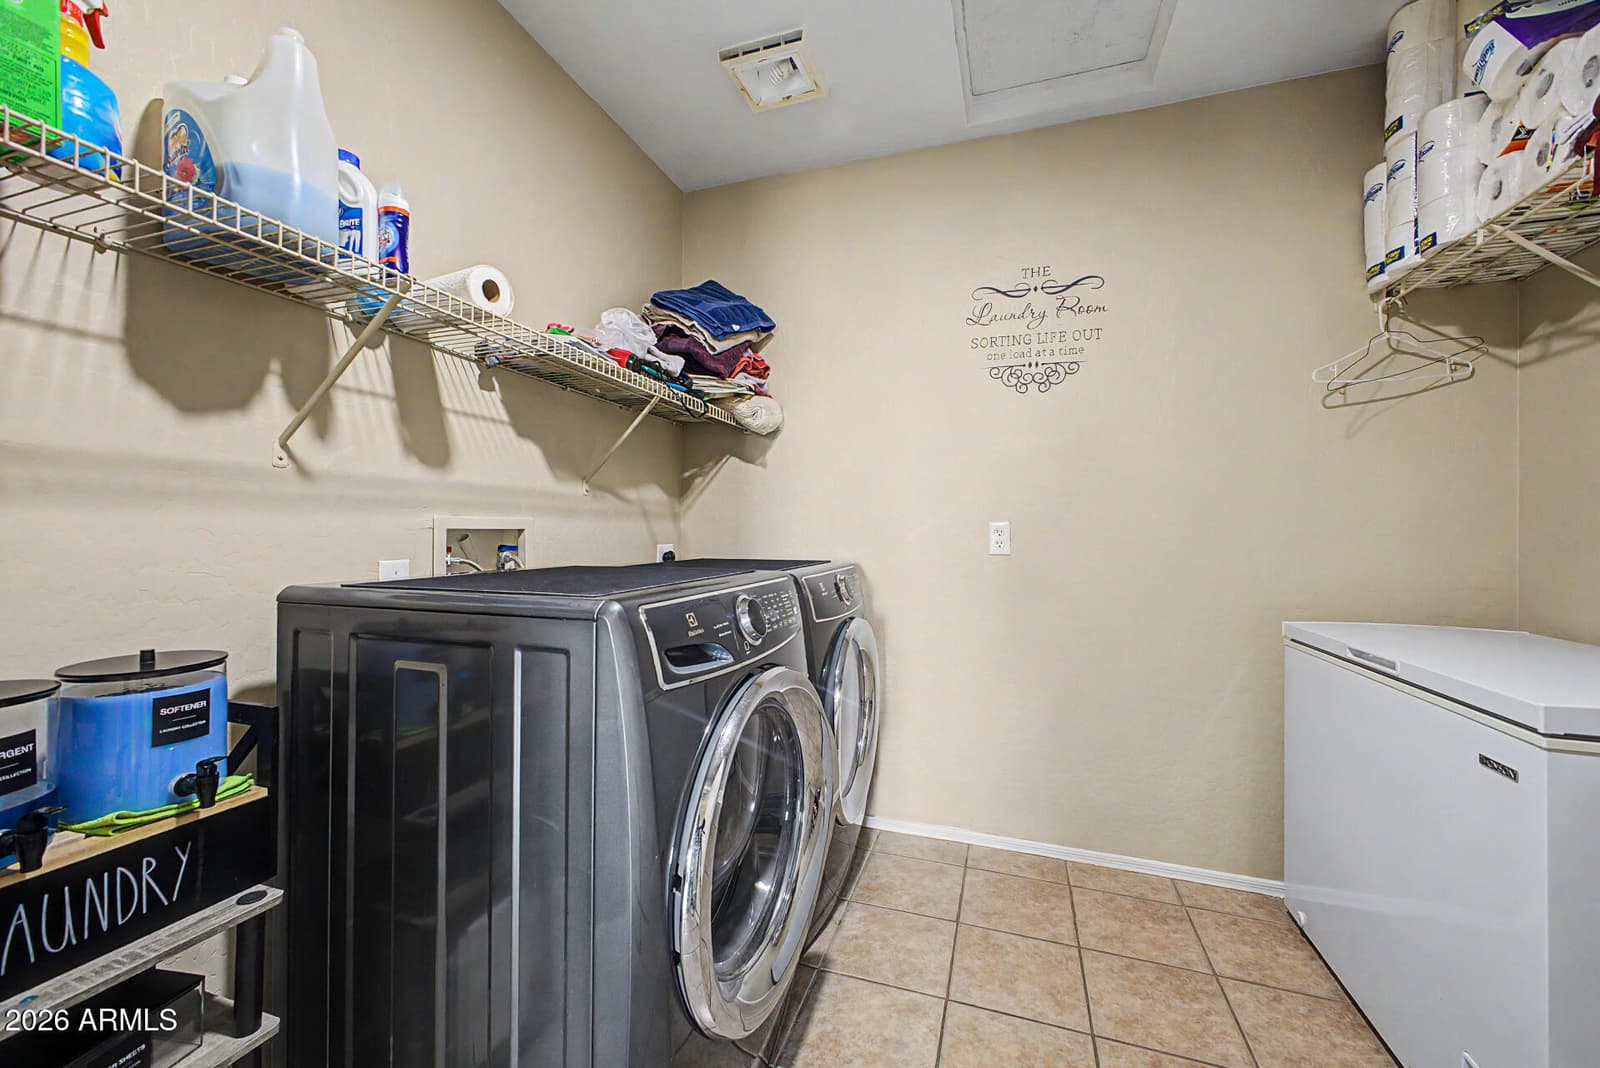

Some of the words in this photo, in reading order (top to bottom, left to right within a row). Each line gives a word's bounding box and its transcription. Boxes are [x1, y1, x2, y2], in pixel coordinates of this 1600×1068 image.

[1021, 265, 1051, 279] THE
[966, 302, 1048, 330] Laundry
[1056, 295, 1109, 319] Room
[970, 333, 1032, 349] SORTING
[1037, 331, 1067, 344] LIFE
[1072, 328, 1103, 341] OUT
[986, 352, 1006, 361] one
[1009, 347, 1032, 359] load
[1035, 348, 1047, 357] at
[1049, 349, 1055, 357] a
[1058, 345, 1085, 356] time
[159, 700, 207, 716] SOFTENER
[0, 841, 192, 976] AUNDRY
